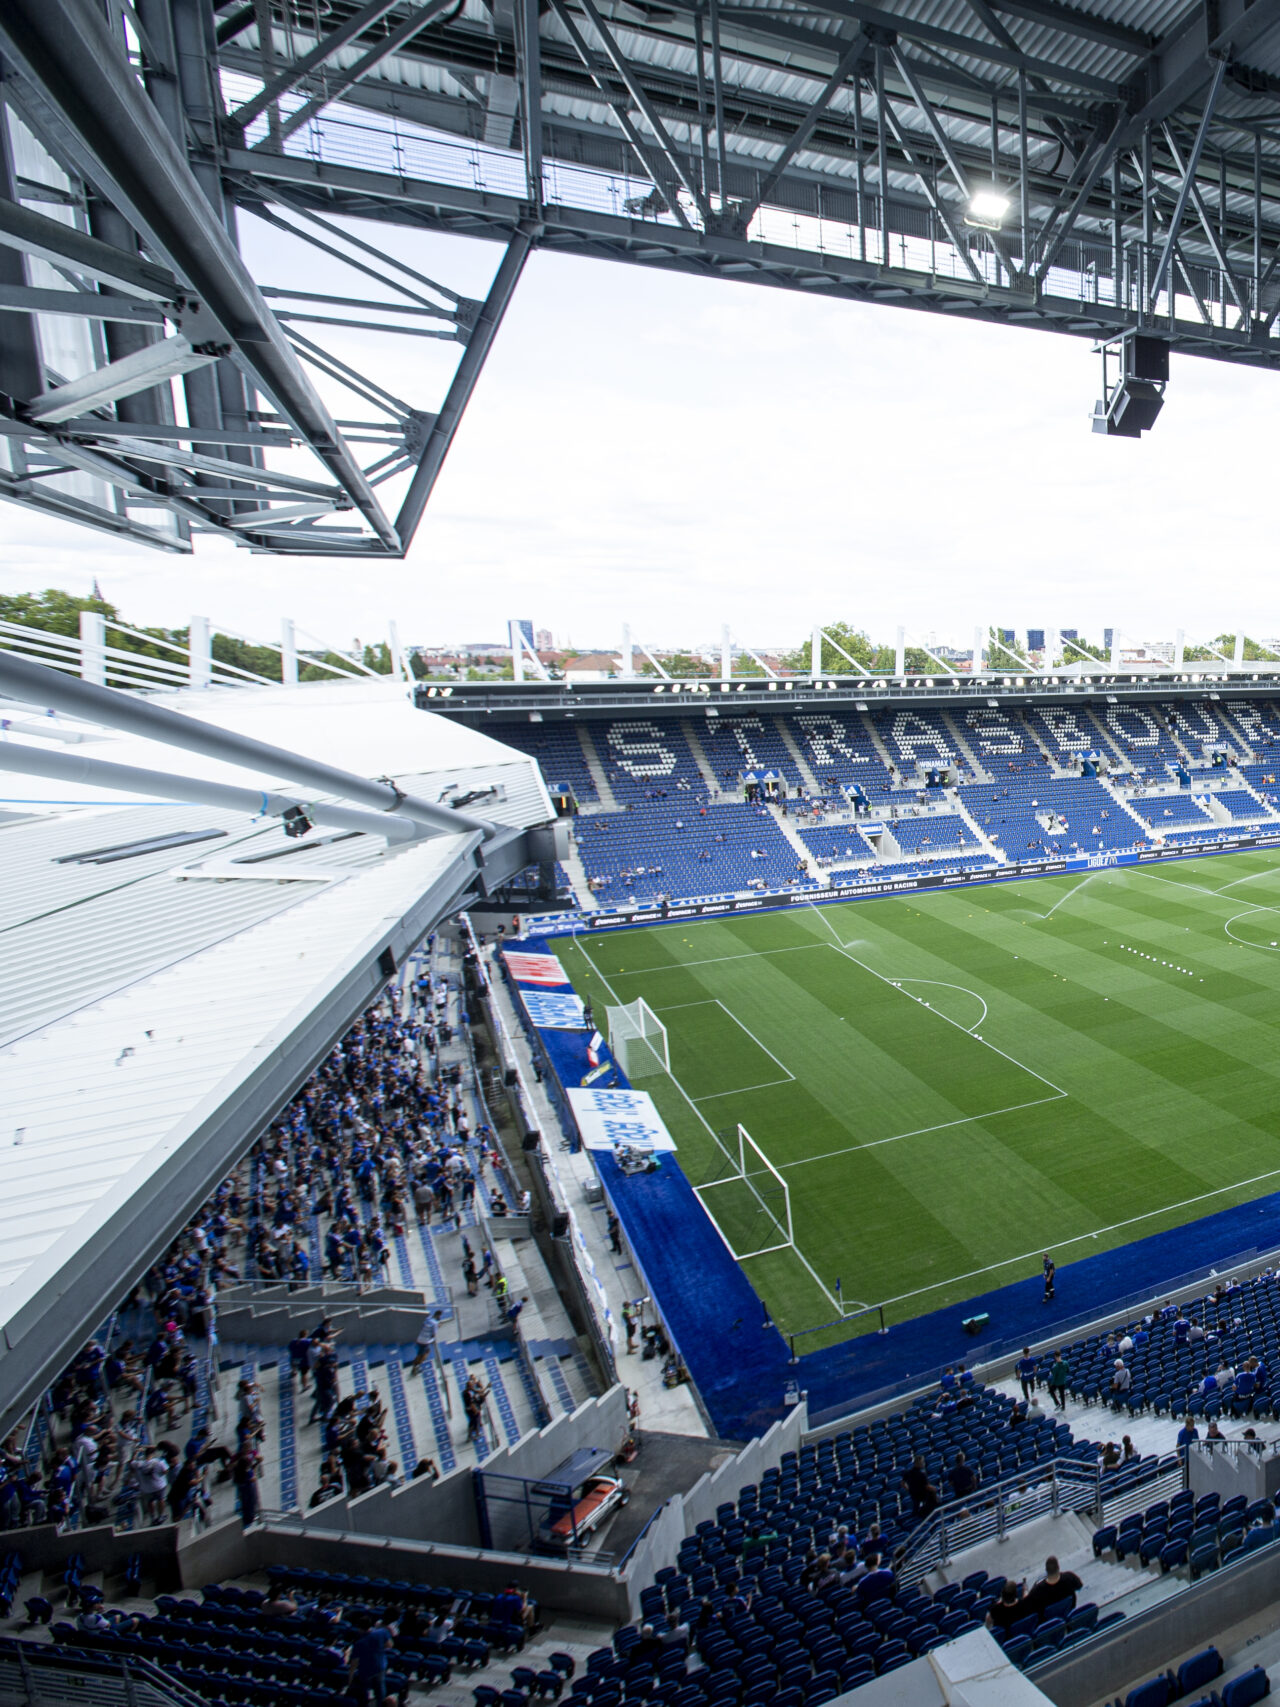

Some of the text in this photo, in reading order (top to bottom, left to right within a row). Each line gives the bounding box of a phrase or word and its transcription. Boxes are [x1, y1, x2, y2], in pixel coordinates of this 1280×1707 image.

[919, 759, 948, 768] WINAMAX
[1087, 857, 1106, 868] LIGUE
[790, 890, 838, 902] FOURNISSEUR
[840, 886, 882, 896] AUTOMOBILE
[894, 881, 918, 889] RACING
